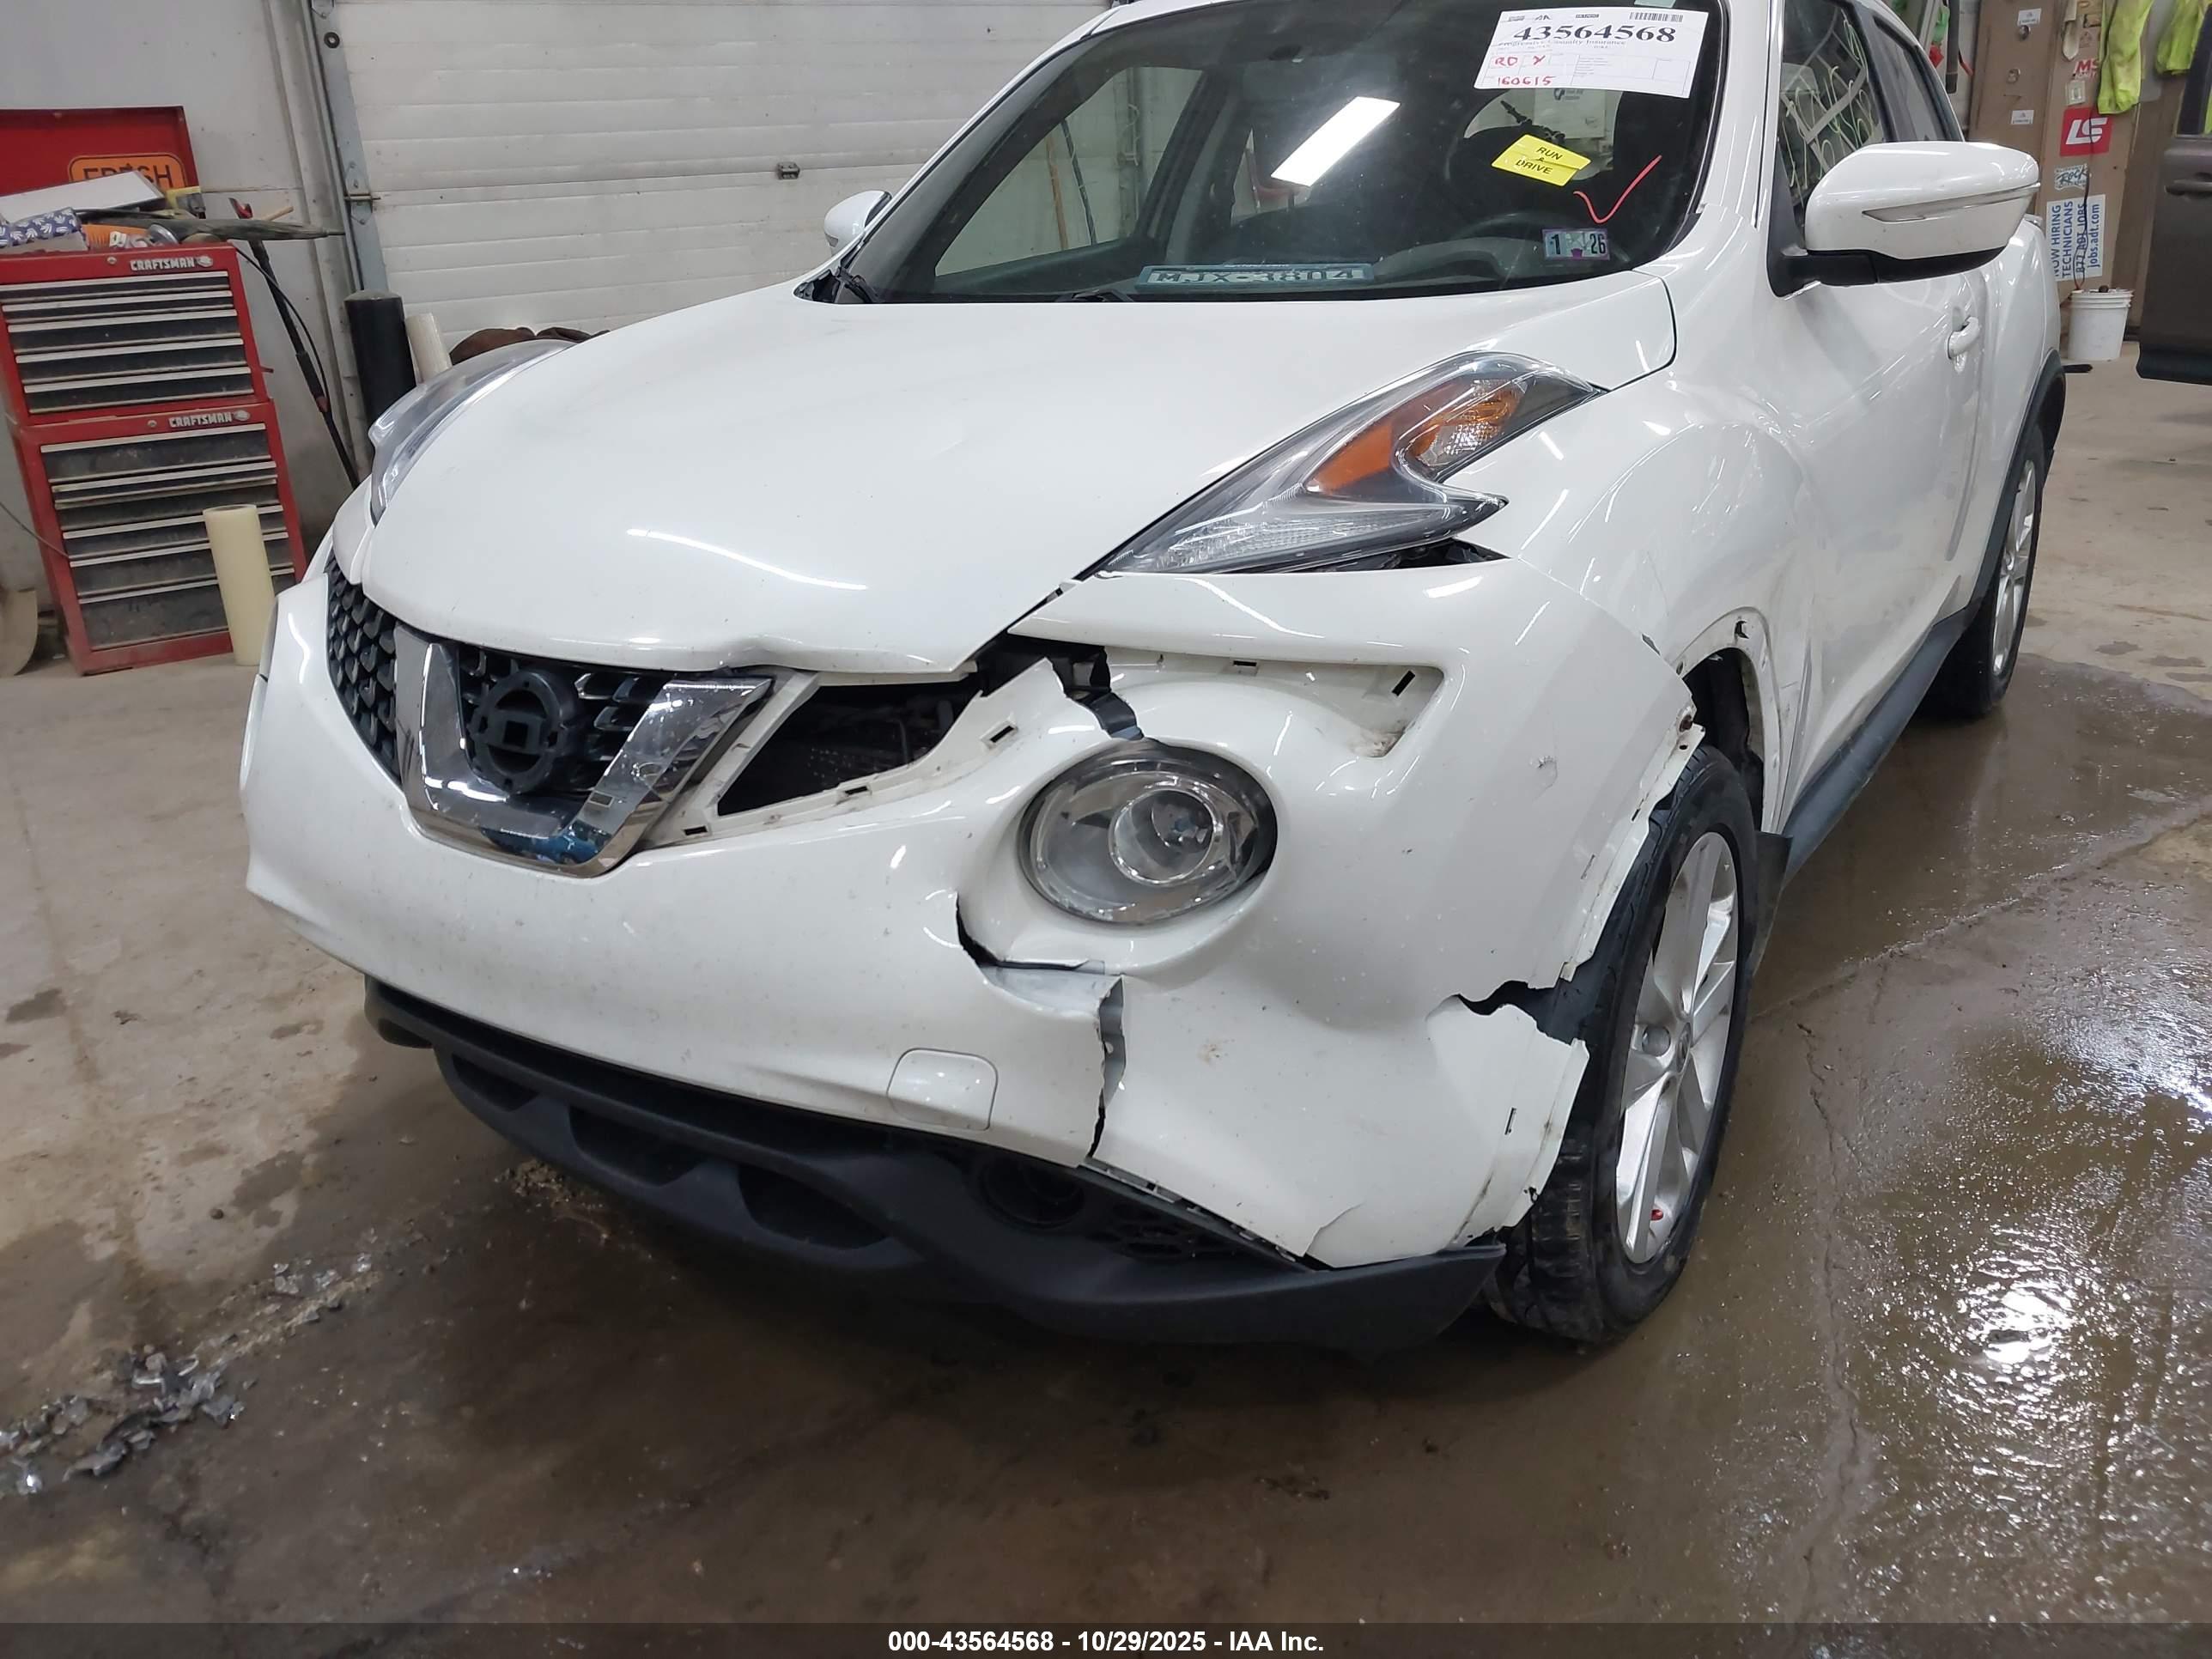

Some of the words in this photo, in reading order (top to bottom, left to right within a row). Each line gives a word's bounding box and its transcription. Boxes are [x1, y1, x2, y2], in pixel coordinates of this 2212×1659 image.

[1514, 24, 1676, 42] 43564568
[1498, 76, 1556, 86] 160615
[1535, 146, 1563, 161] RUN
[82, 163, 173, 188] FSH
[1515, 159, 1553, 174] DRIVE
[2051, 205, 2062, 245] HIRING
[1550, 234, 1561, 254] 1
[1589, 234, 1607, 254] 26
[2062, 201, 2074, 277] TECHNICIANS
[130, 257, 196, 271] CRAFTSMAN
[2051, 249, 2060, 276] NOW
[168, 412, 233, 428] CRAFTSMAN
